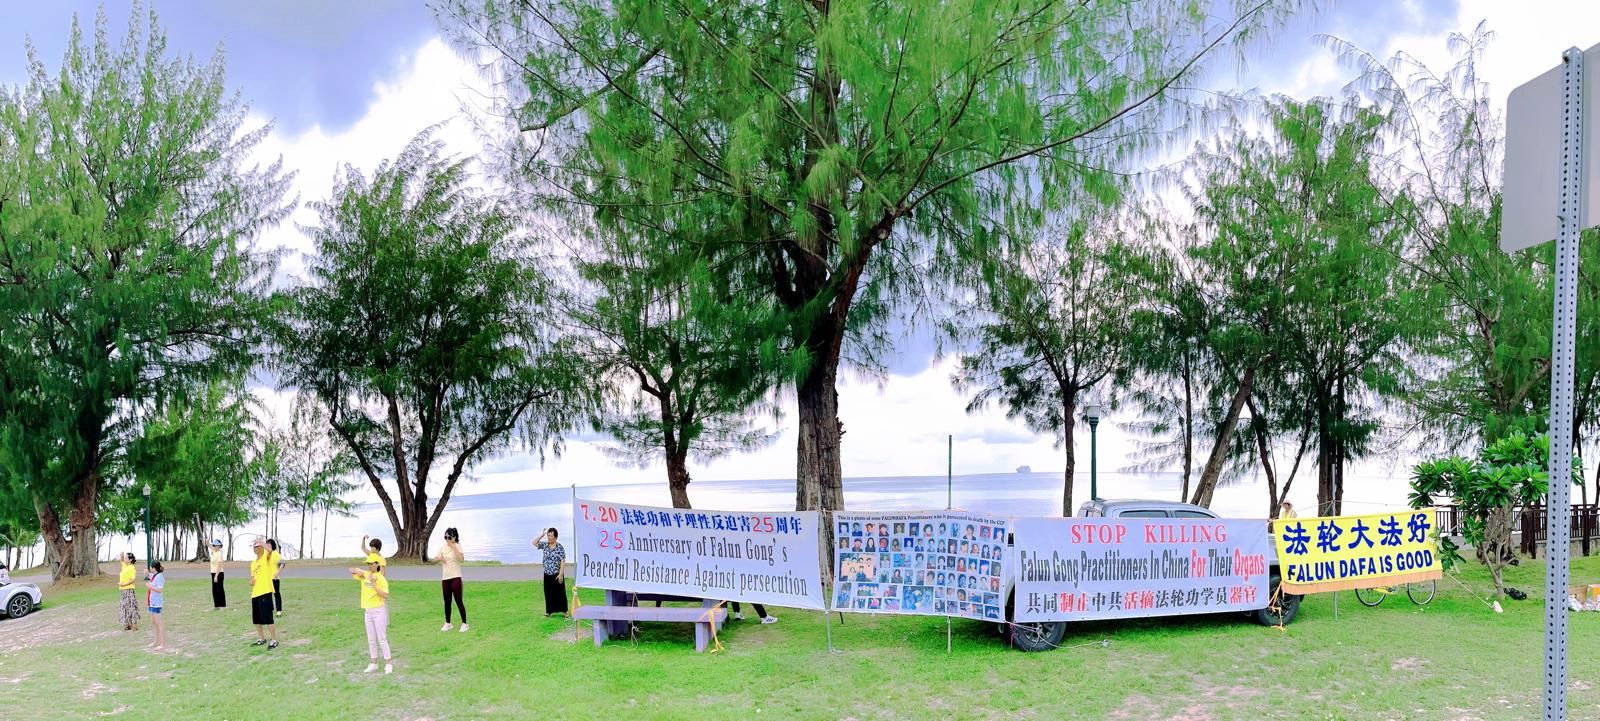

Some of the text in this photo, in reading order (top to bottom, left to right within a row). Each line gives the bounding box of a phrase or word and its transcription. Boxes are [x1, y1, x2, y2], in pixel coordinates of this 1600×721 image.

[581, 504, 617, 523] 7.20
[600, 530, 623, 550] 25
[628, 531, 692, 560] Anniversary
[696, 536, 707, 556] of
[710, 536, 741, 558] Falun
[1071, 524, 1226, 544] STOP KILLING
[1282, 513, 1430, 555] 法轮大法好
[583, 554, 808, 596] Peaceful Resistance Against persecution
[1020, 547, 1264, 588] Falun Gong Practitioners In China For Their Organs
[1288, 550, 1433, 582] FALUN DAFA IS GOOD
